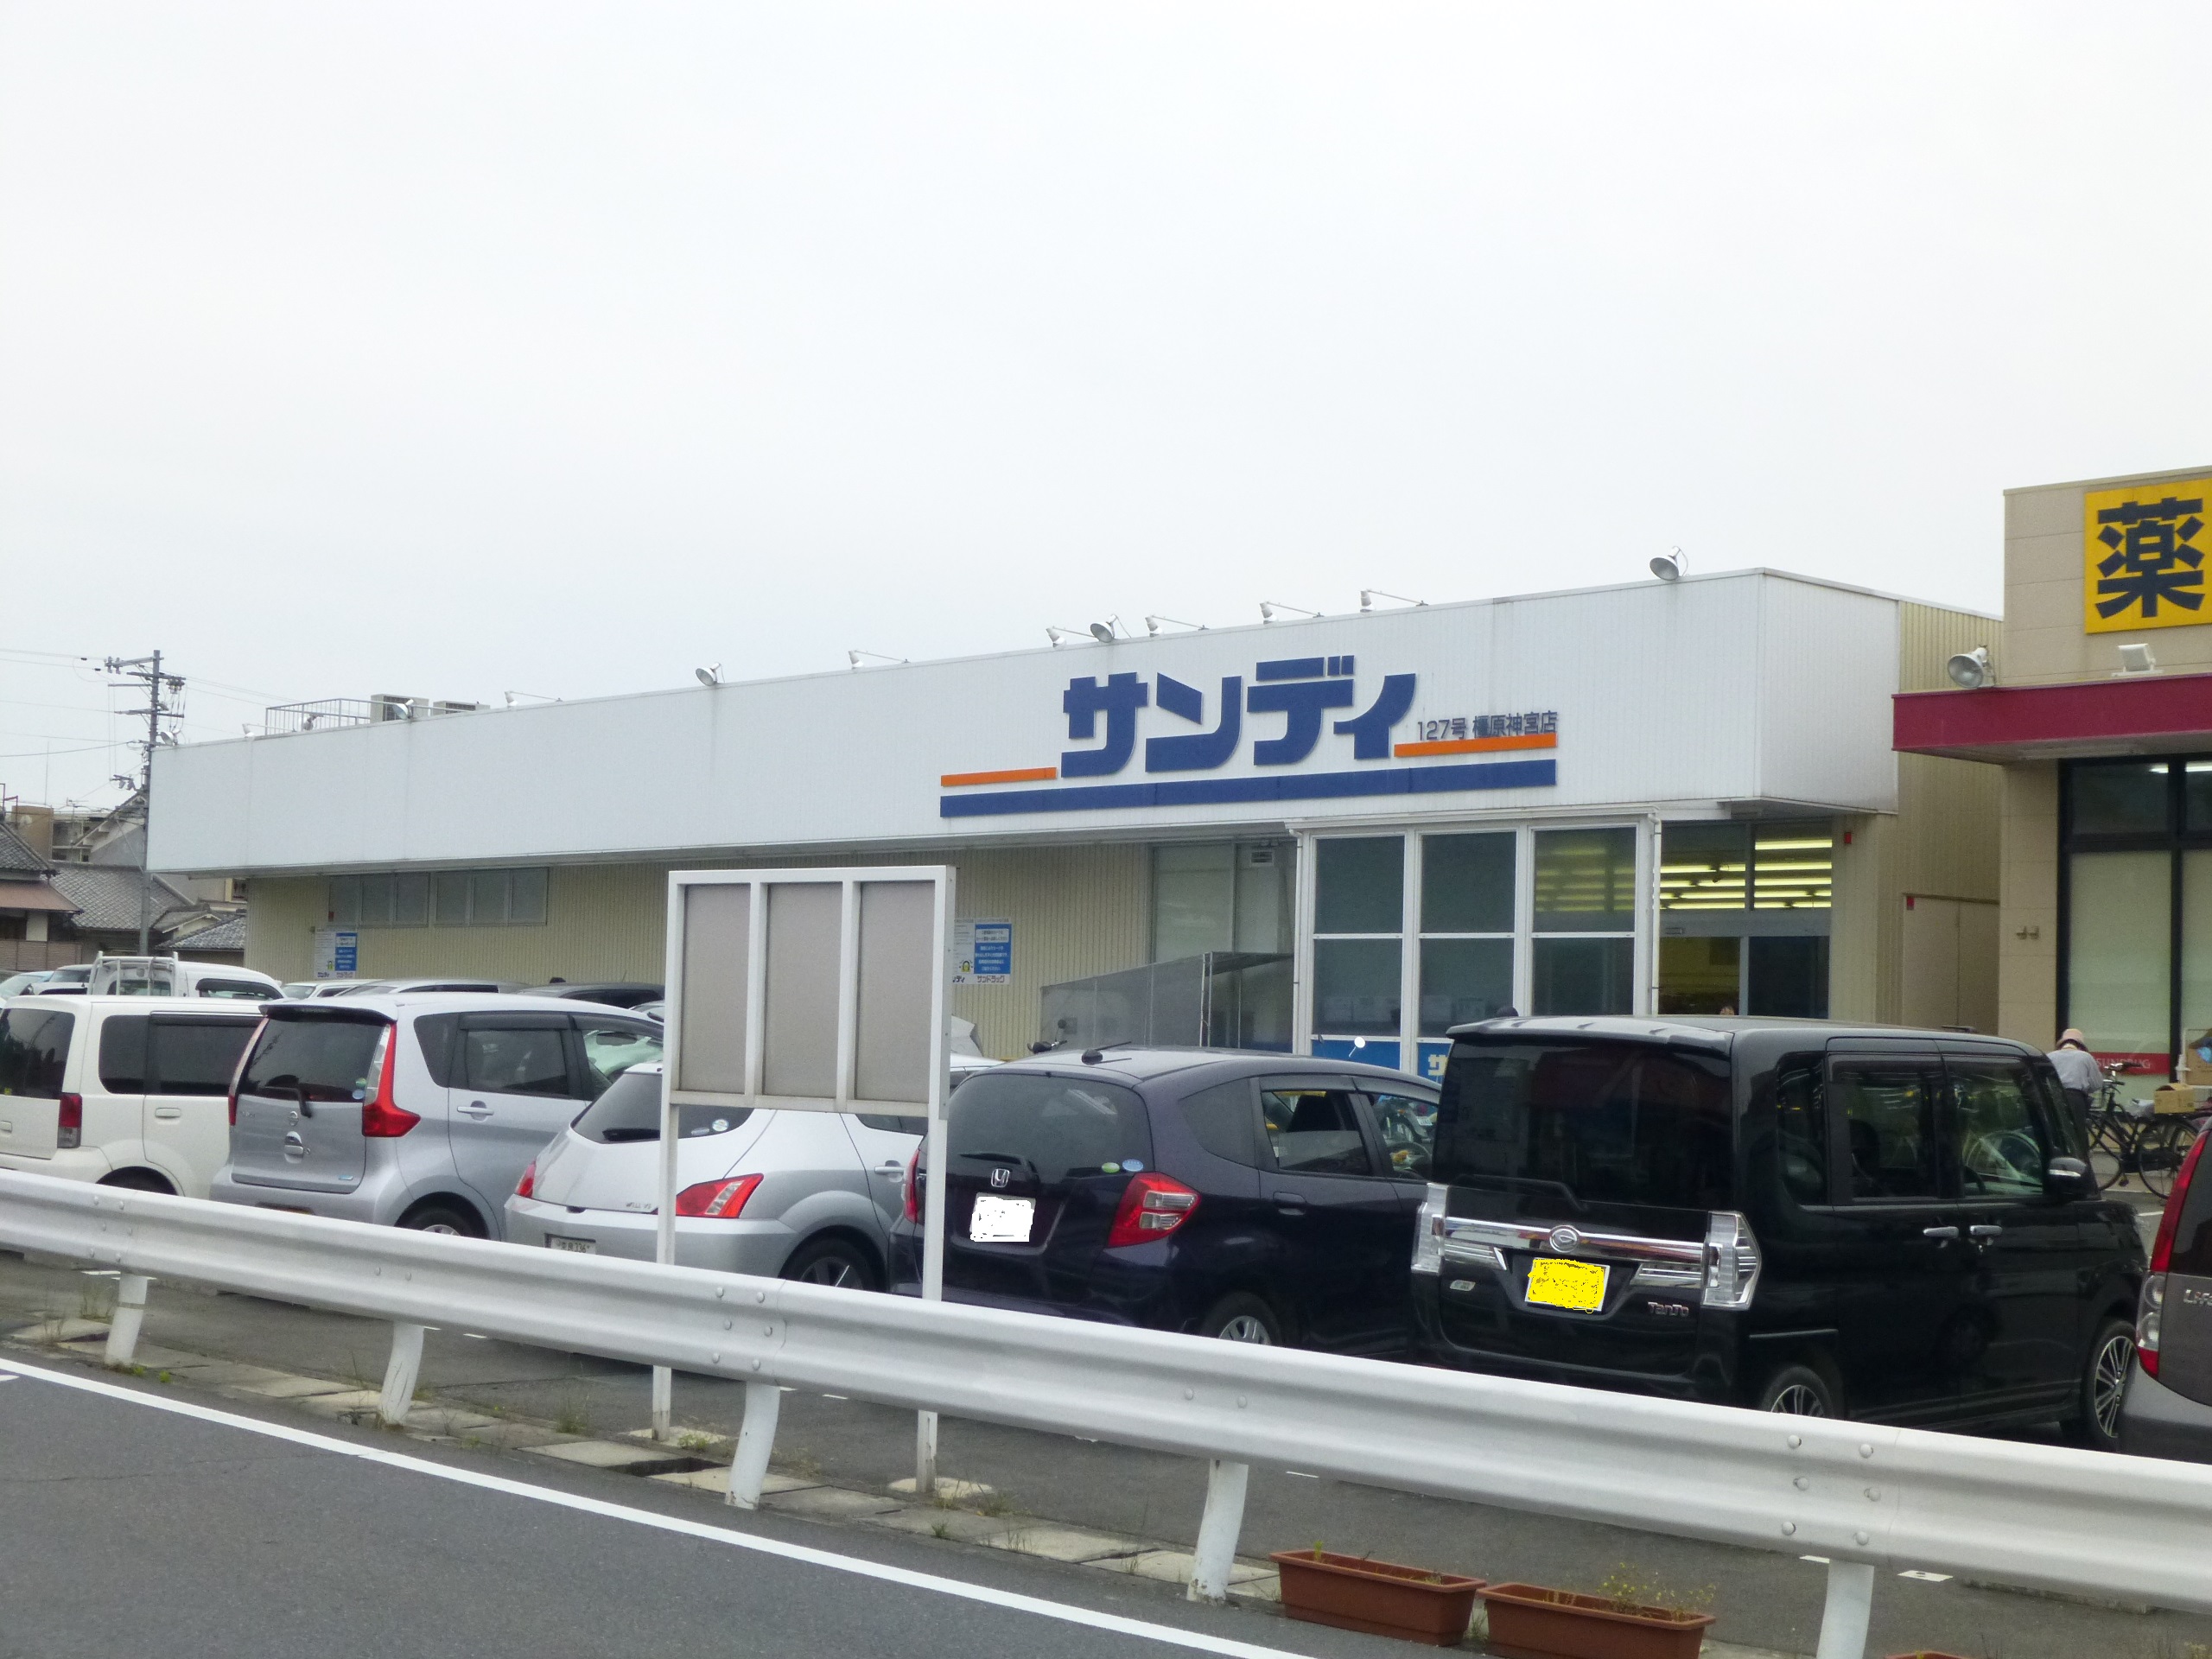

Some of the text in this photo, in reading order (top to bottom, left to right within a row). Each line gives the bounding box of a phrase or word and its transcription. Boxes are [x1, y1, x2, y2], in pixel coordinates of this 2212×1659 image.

[2095, 497, 2205, 619] 薬
[1061, 656, 1416, 779] サンディ
[1418, 717, 1467, 741] 127号
